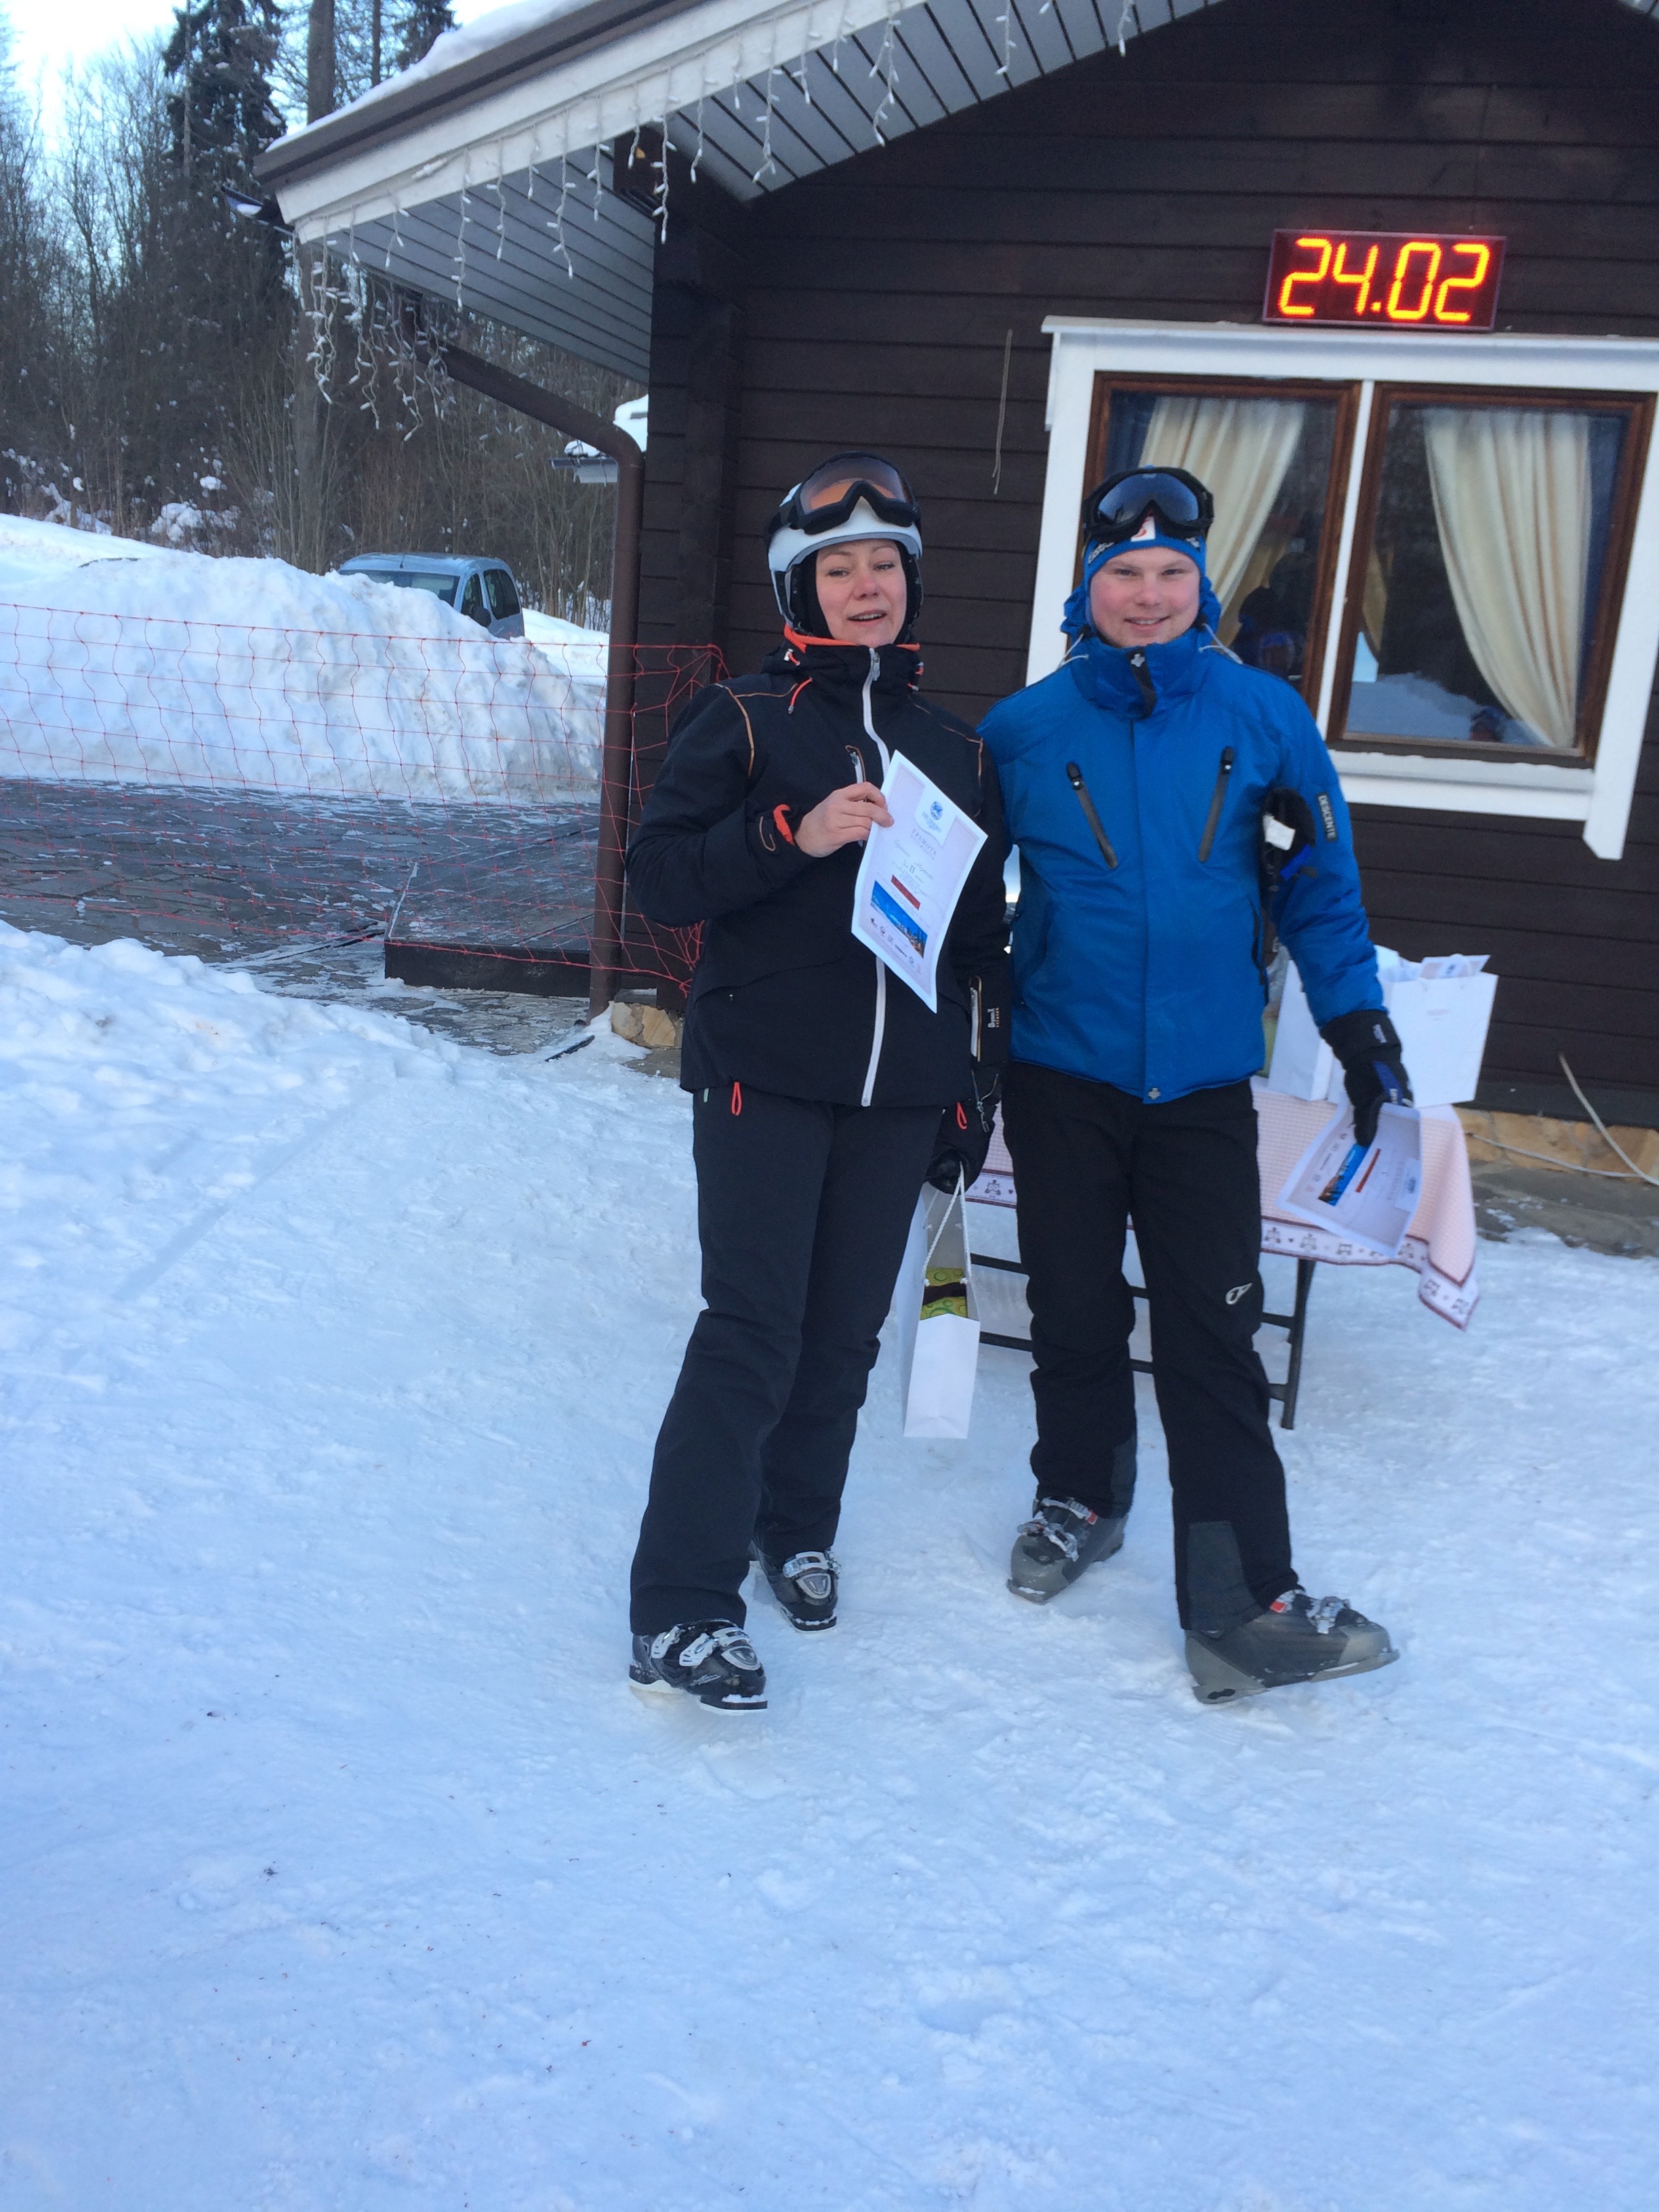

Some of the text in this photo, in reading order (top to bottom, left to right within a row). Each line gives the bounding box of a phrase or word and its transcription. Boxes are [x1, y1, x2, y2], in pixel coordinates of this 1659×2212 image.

[1277, 237, 1490, 323] 24.02
[1317, 795, 1336, 839] DESCENTE
[912, 828, 937, 856] ГРАМОТА
